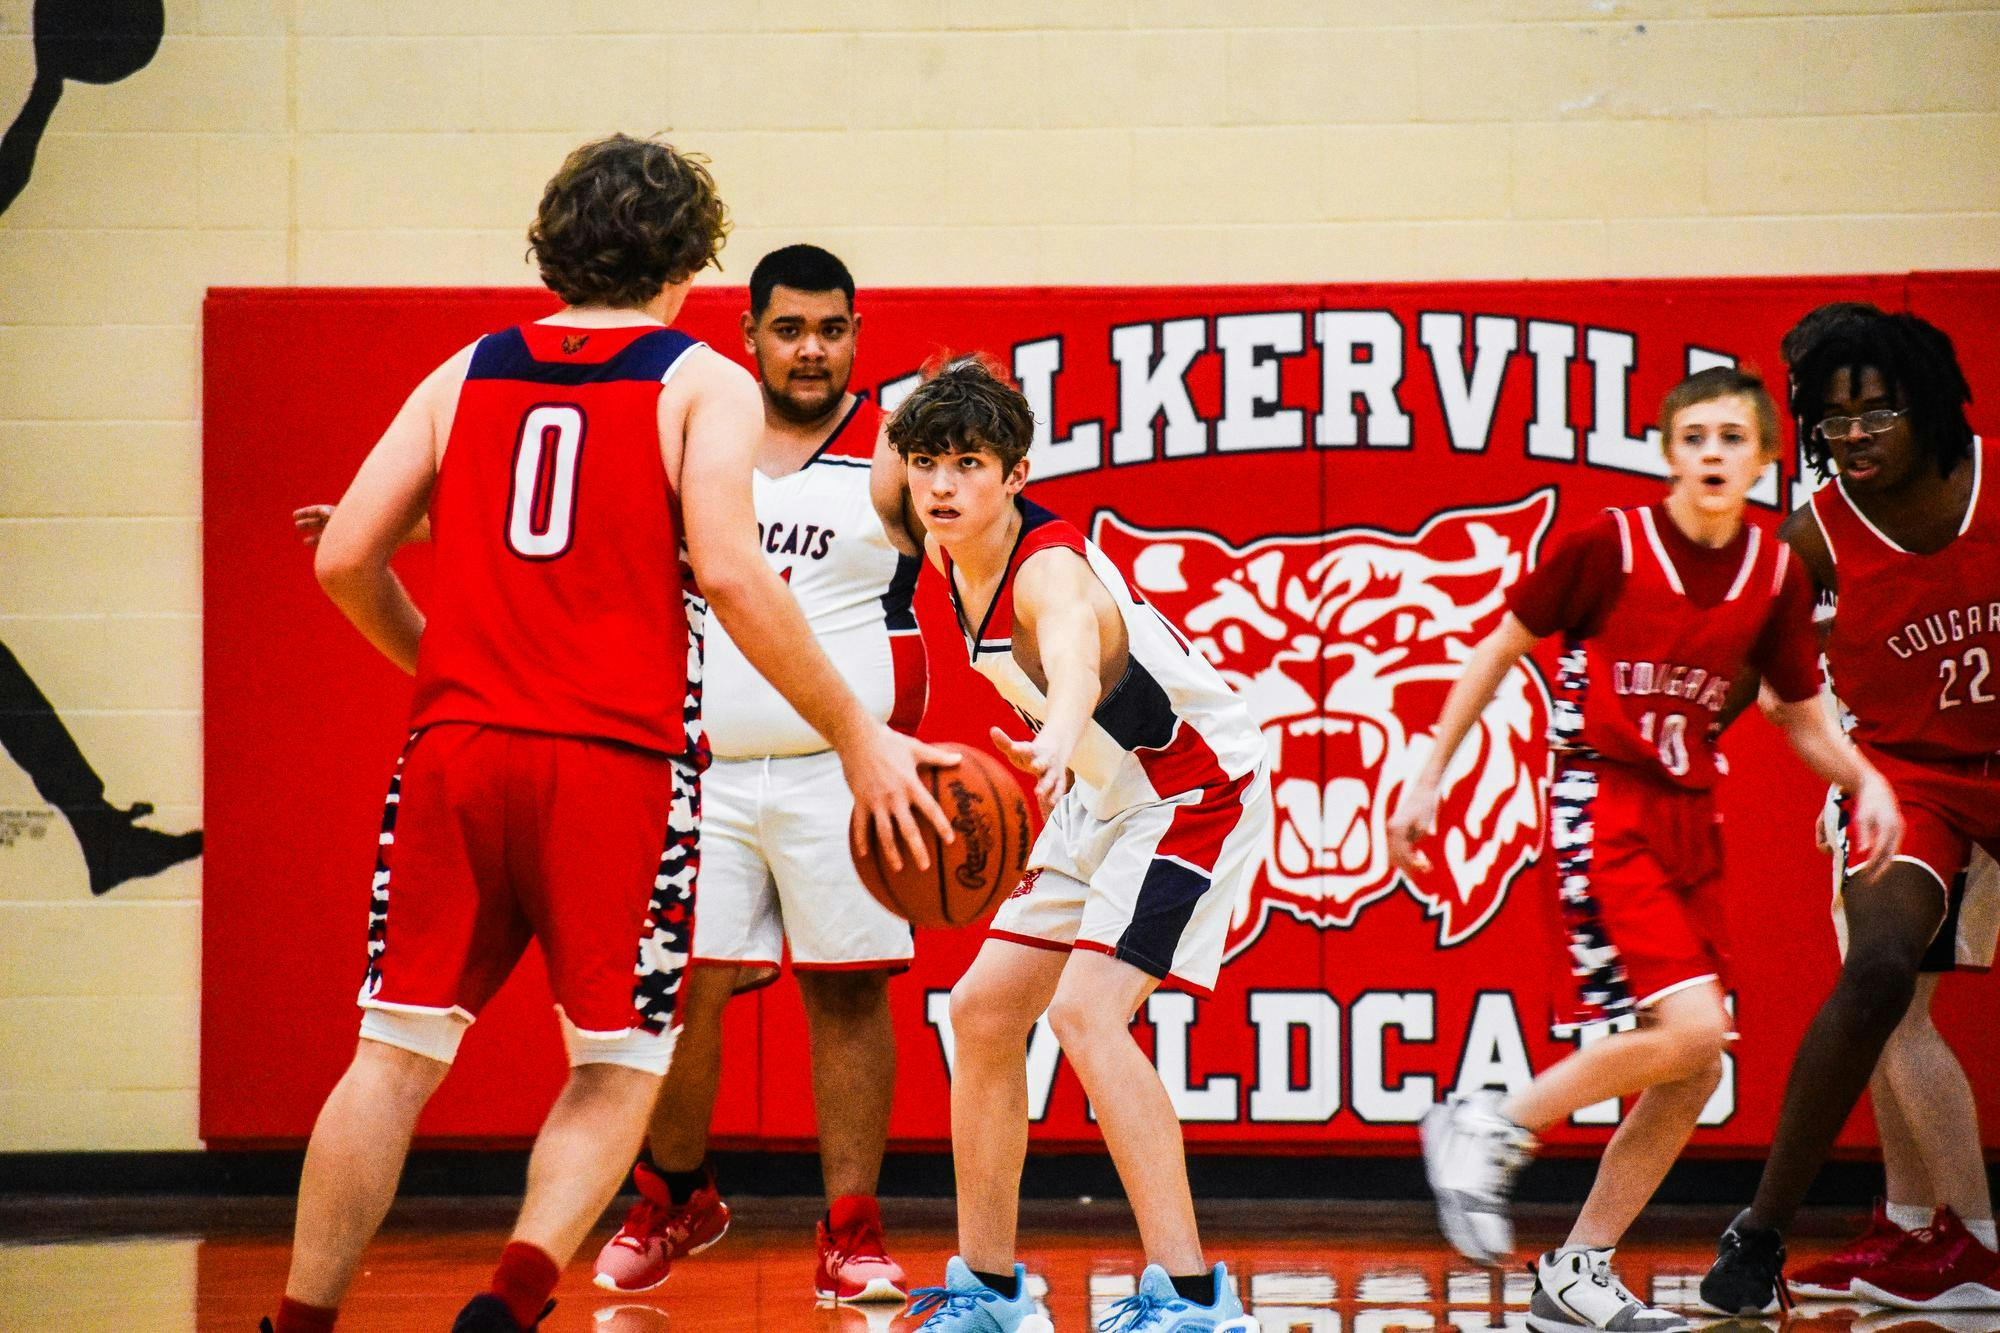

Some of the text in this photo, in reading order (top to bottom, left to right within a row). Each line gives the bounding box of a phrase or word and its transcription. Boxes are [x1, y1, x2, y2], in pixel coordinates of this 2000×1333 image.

[877, 309, 1838, 512] LKERVIL
[504, 402, 588, 562] 0
[1639, 711, 1691, 777] 10
[1938, 646, 1997, 711] 22
[926, 989, 1737, 1126] LDCA
